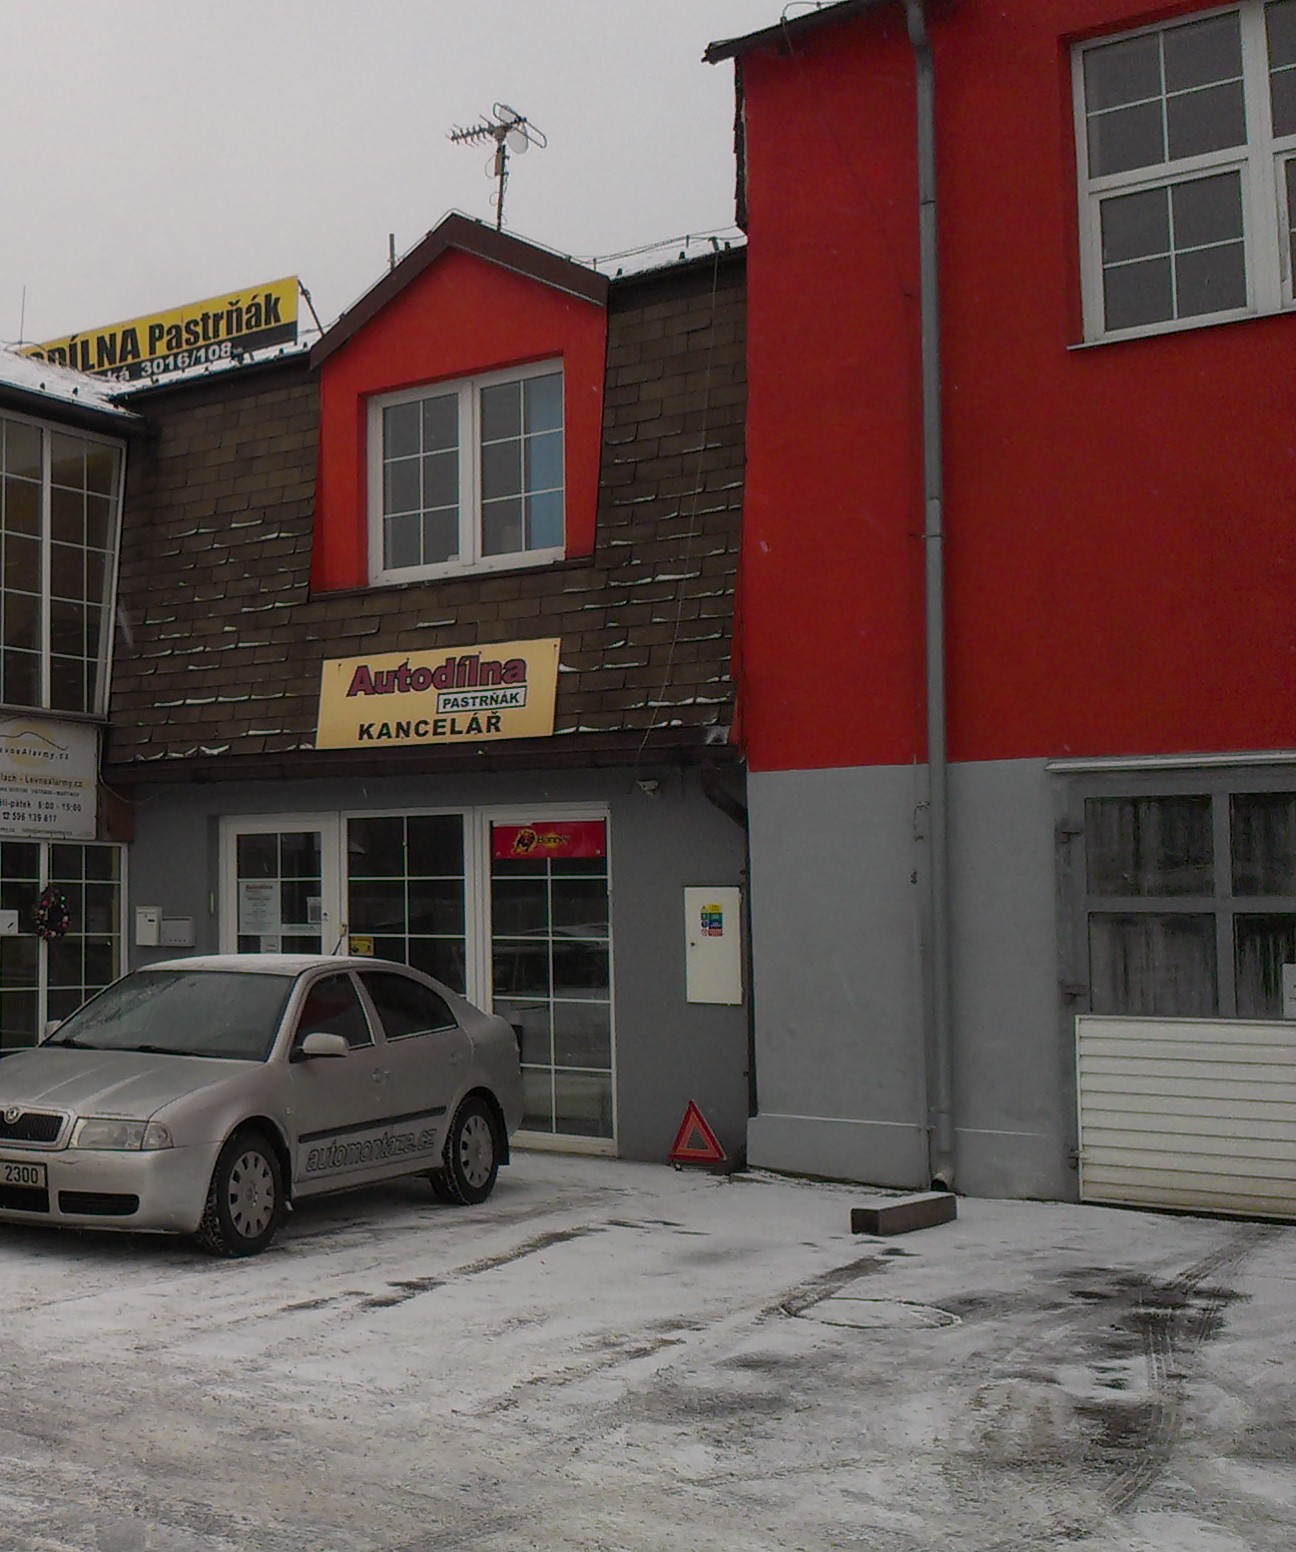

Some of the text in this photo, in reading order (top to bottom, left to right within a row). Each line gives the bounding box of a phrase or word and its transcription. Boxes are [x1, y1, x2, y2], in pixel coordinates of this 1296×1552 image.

[149, 292, 282, 355] Pastrňák
[141, 341, 231, 378] 3016/108
[346, 655, 527, 697] Autodílna
[442, 691, 521, 710] PASTRŇÁK
[358, 710, 502, 741] KANCELÁŘ
[306, 1128, 438, 1172] automontaze.cz
[5, 1165, 39, 1185] 2300
